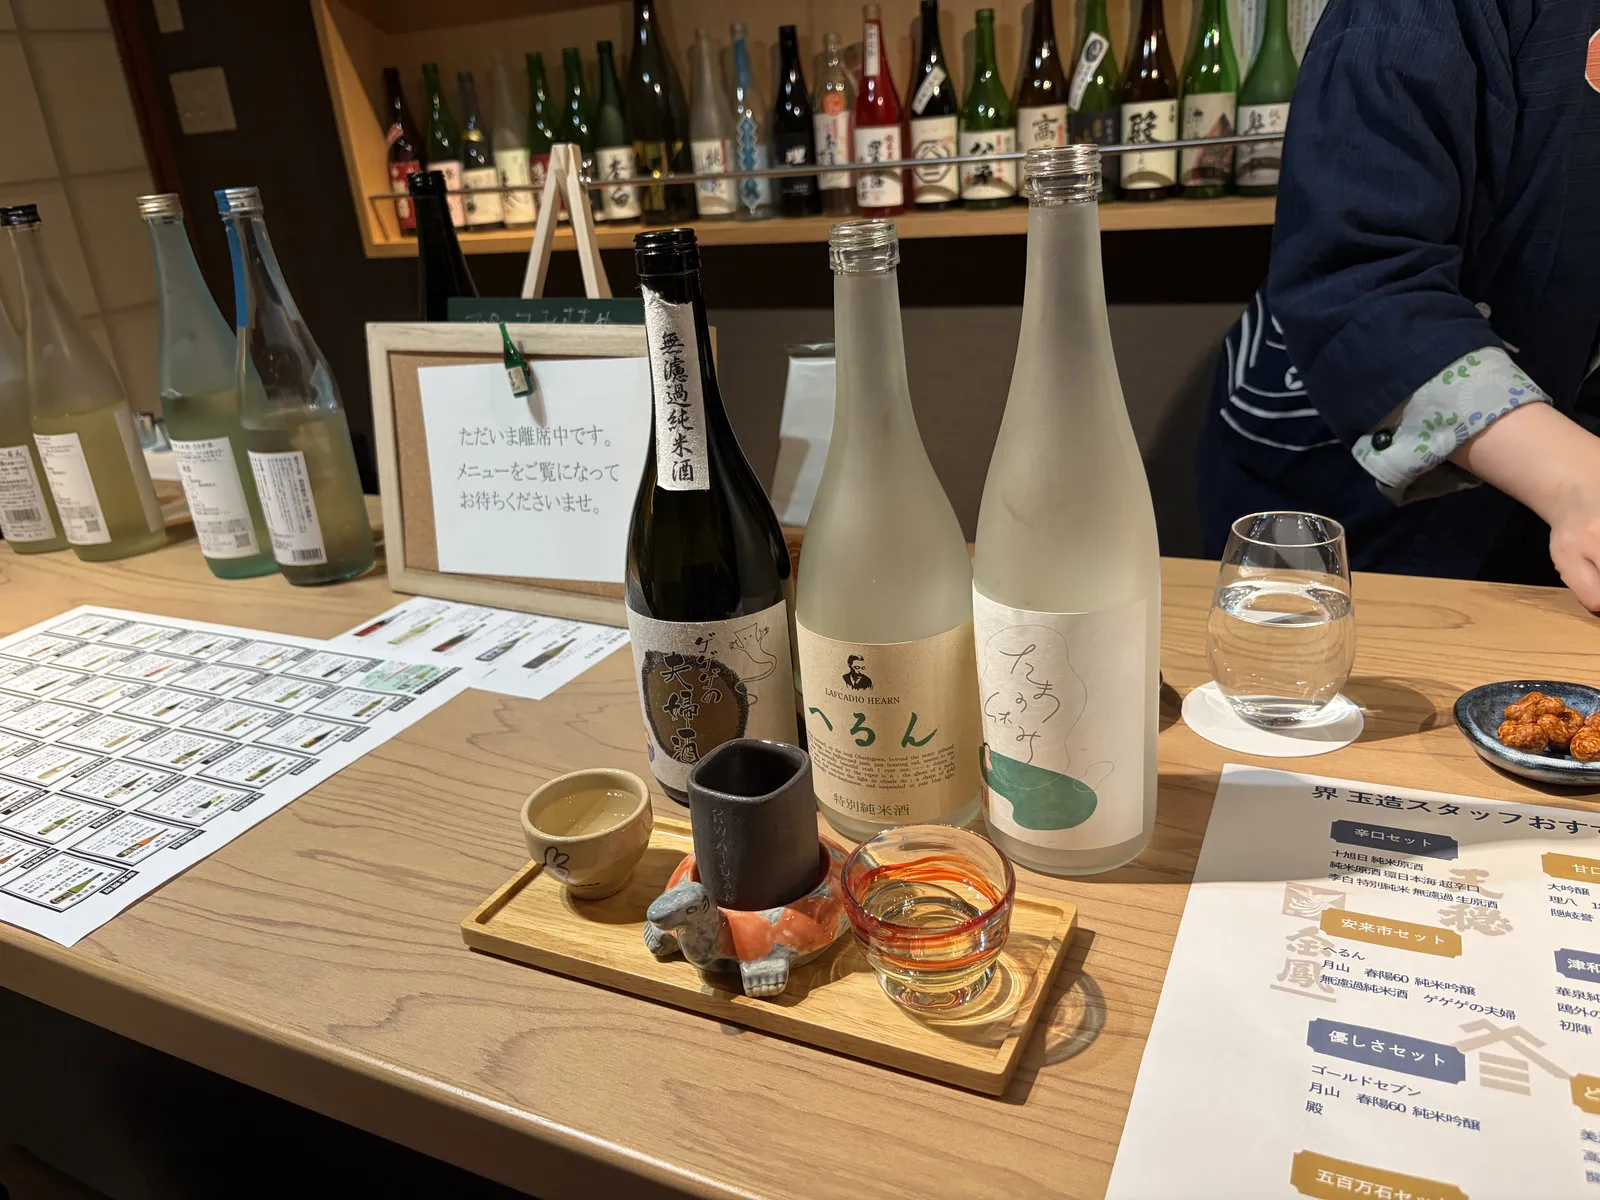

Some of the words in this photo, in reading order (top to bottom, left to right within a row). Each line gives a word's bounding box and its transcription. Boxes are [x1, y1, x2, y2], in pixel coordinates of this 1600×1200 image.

[659, 331, 694, 482] 無濾過純米酒
[459, 425, 611, 447] ただいま離席中です。
[457, 461, 620, 482] メニューをご覧になって
[459, 491, 600, 515] お待ちくださいませ。
[694, 632, 723, 703] ゲゲゲの
[825, 688, 865, 704] LAFCADIO
[867, 696, 900, 705] HEARN
[808, 706, 938, 748] へるん
[833, 793, 910, 817] 特別純米酒
[1311, 785, 1339, 800] 界
[1353, 828, 1433, 848] 辛口セット
[1331, 850, 1368, 862] 十旭日
[1370, 855, 1424, 872] 純米原酒
[1329, 861, 1382, 877] 純米原酒
[1383, 870, 1437, 886] 環日本海
[1438, 879, 1480, 893] 超辛口
[1328, 873, 1354, 885] 李白
[1356, 878, 1411, 894] 特別純米
[1412, 888, 1454, 903] 無濾過
[1455, 896, 1498, 909] 生原酒
[1548, 895, 1578, 907] 理八
[1340, 918, 1446, 945] 安来市セット
[1324, 946, 1366, 961] へるん
[1322, 959, 1350, 973] 月山
[1363, 968, 1410, 984] 春陽60
[1414, 976, 1477, 997] 純米吟醸
[1319, 974, 1409, 999] 無濾過純米酒
[1423, 994, 1517, 1021] ゲゲゲの夫婦
[1559, 1020, 1593, 1035] 初陣
[1328, 1029, 1446, 1067] 優しさセット
[1311, 1064, 1422, 1097] ゴールドセブン
[1305, 1099, 1324, 1115] 殿
[1308, 1081, 1340, 1098] 月山
[1356, 1093, 1407, 1113] 春陽60
[1412, 1105, 1482, 1131] 純米吟醸
[1315, 1168, 1445, 1200] 五百万石セ
